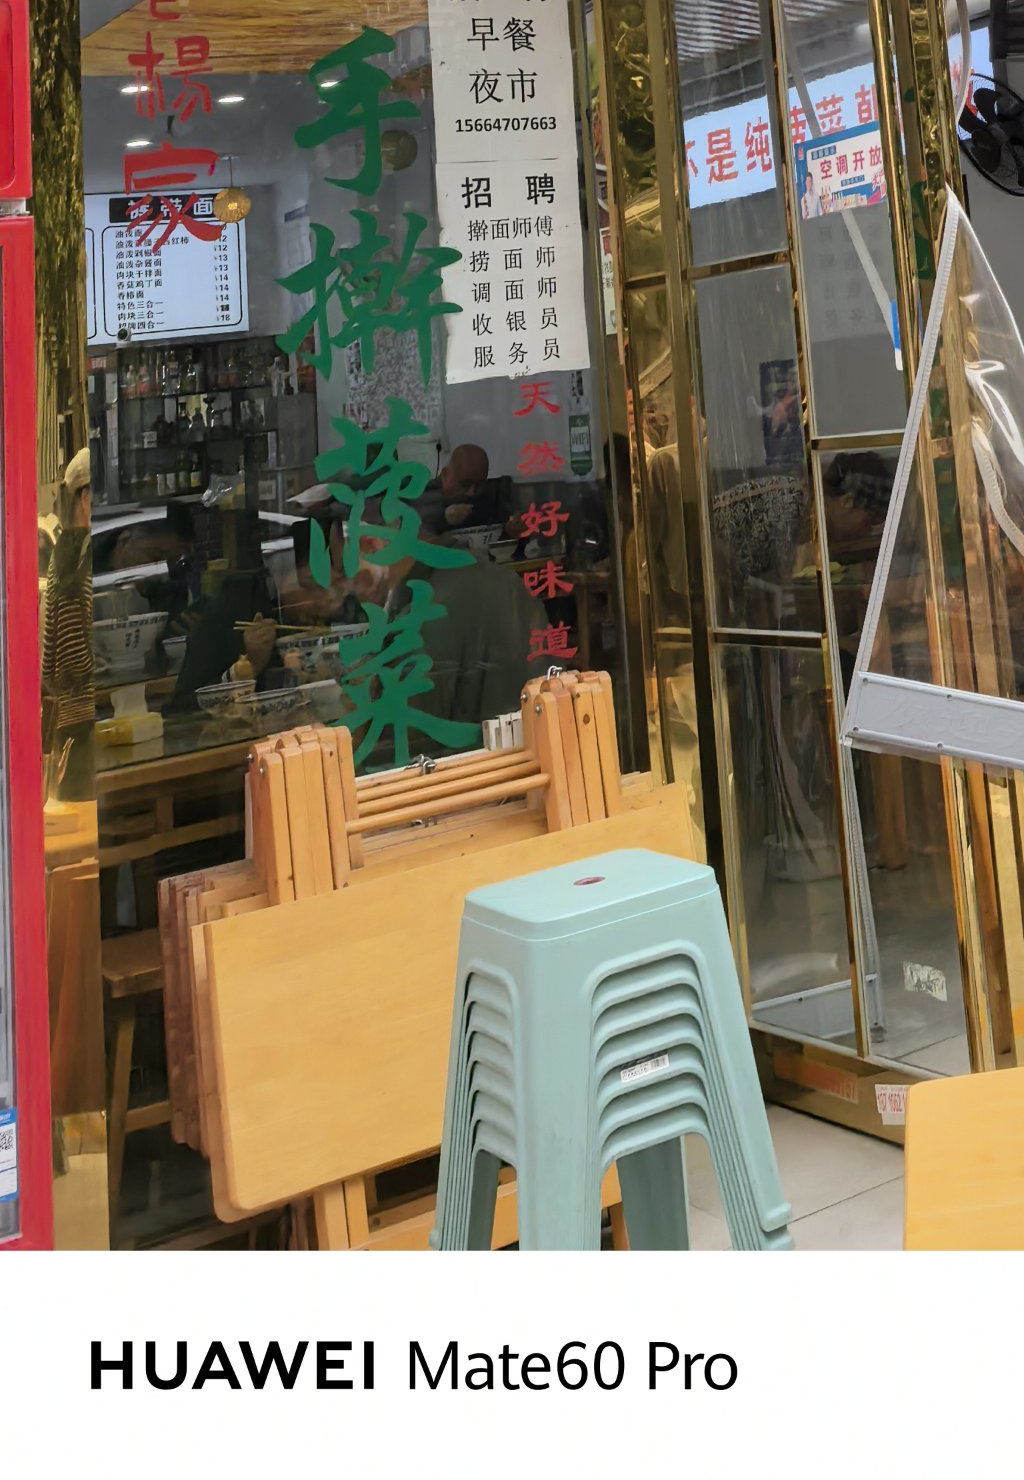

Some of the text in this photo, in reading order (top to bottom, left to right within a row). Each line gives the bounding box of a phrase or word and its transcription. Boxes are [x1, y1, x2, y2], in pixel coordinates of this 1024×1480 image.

[467, 17, 536, 52] 早餐
[469, 68, 538, 104] 夜市
[456, 116, 557, 133] 15664707663
[820, 145, 882, 180] 空调开放
[461, 172, 556, 209] 招聘
[467, 215, 553, 242] 擀面师傅
[469, 246, 555, 272] 捞面师
[472, 276, 557, 303] 调面师
[117, 300, 164, 311] 特色三合一
[472, 307, 558, 336] 收银员
[473, 338, 560, 368] 服务员
[273, 24, 482, 770] 手擀菠菜
[513, 381, 578, 662] 天然好味道
